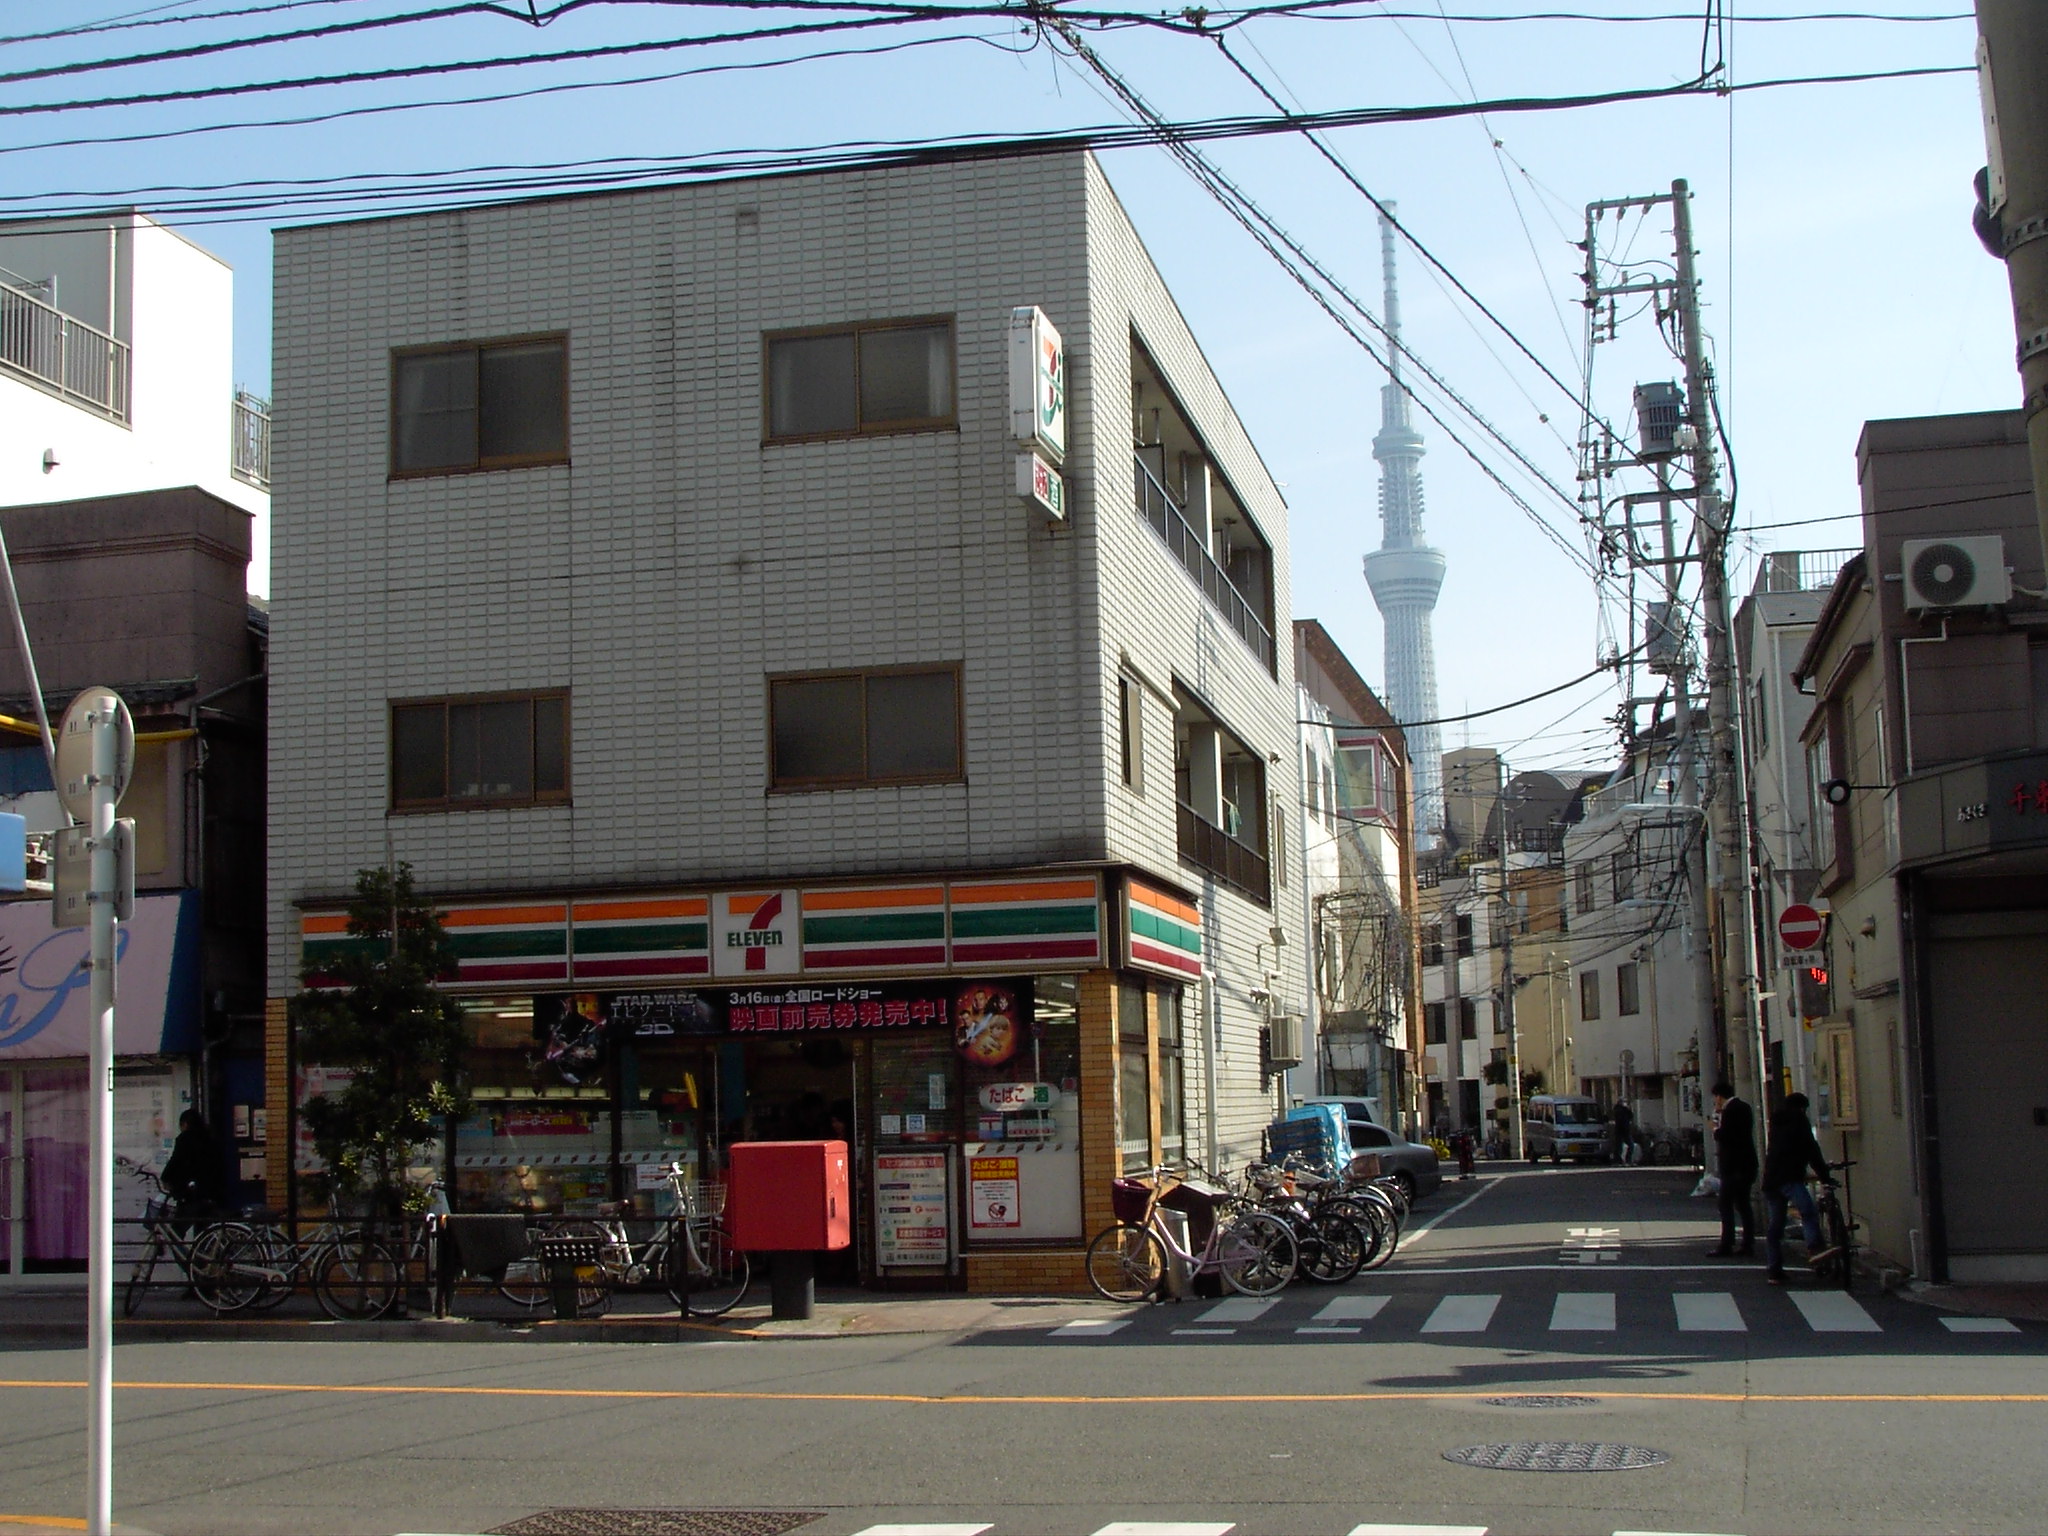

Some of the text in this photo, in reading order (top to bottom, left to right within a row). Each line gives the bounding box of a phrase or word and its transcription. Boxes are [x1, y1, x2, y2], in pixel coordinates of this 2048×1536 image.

[610, 993, 698, 1006] STAR WARS
[634, 1023, 675, 1035] 3D
[989, 1085, 1050, 1104] たばこ 酒
